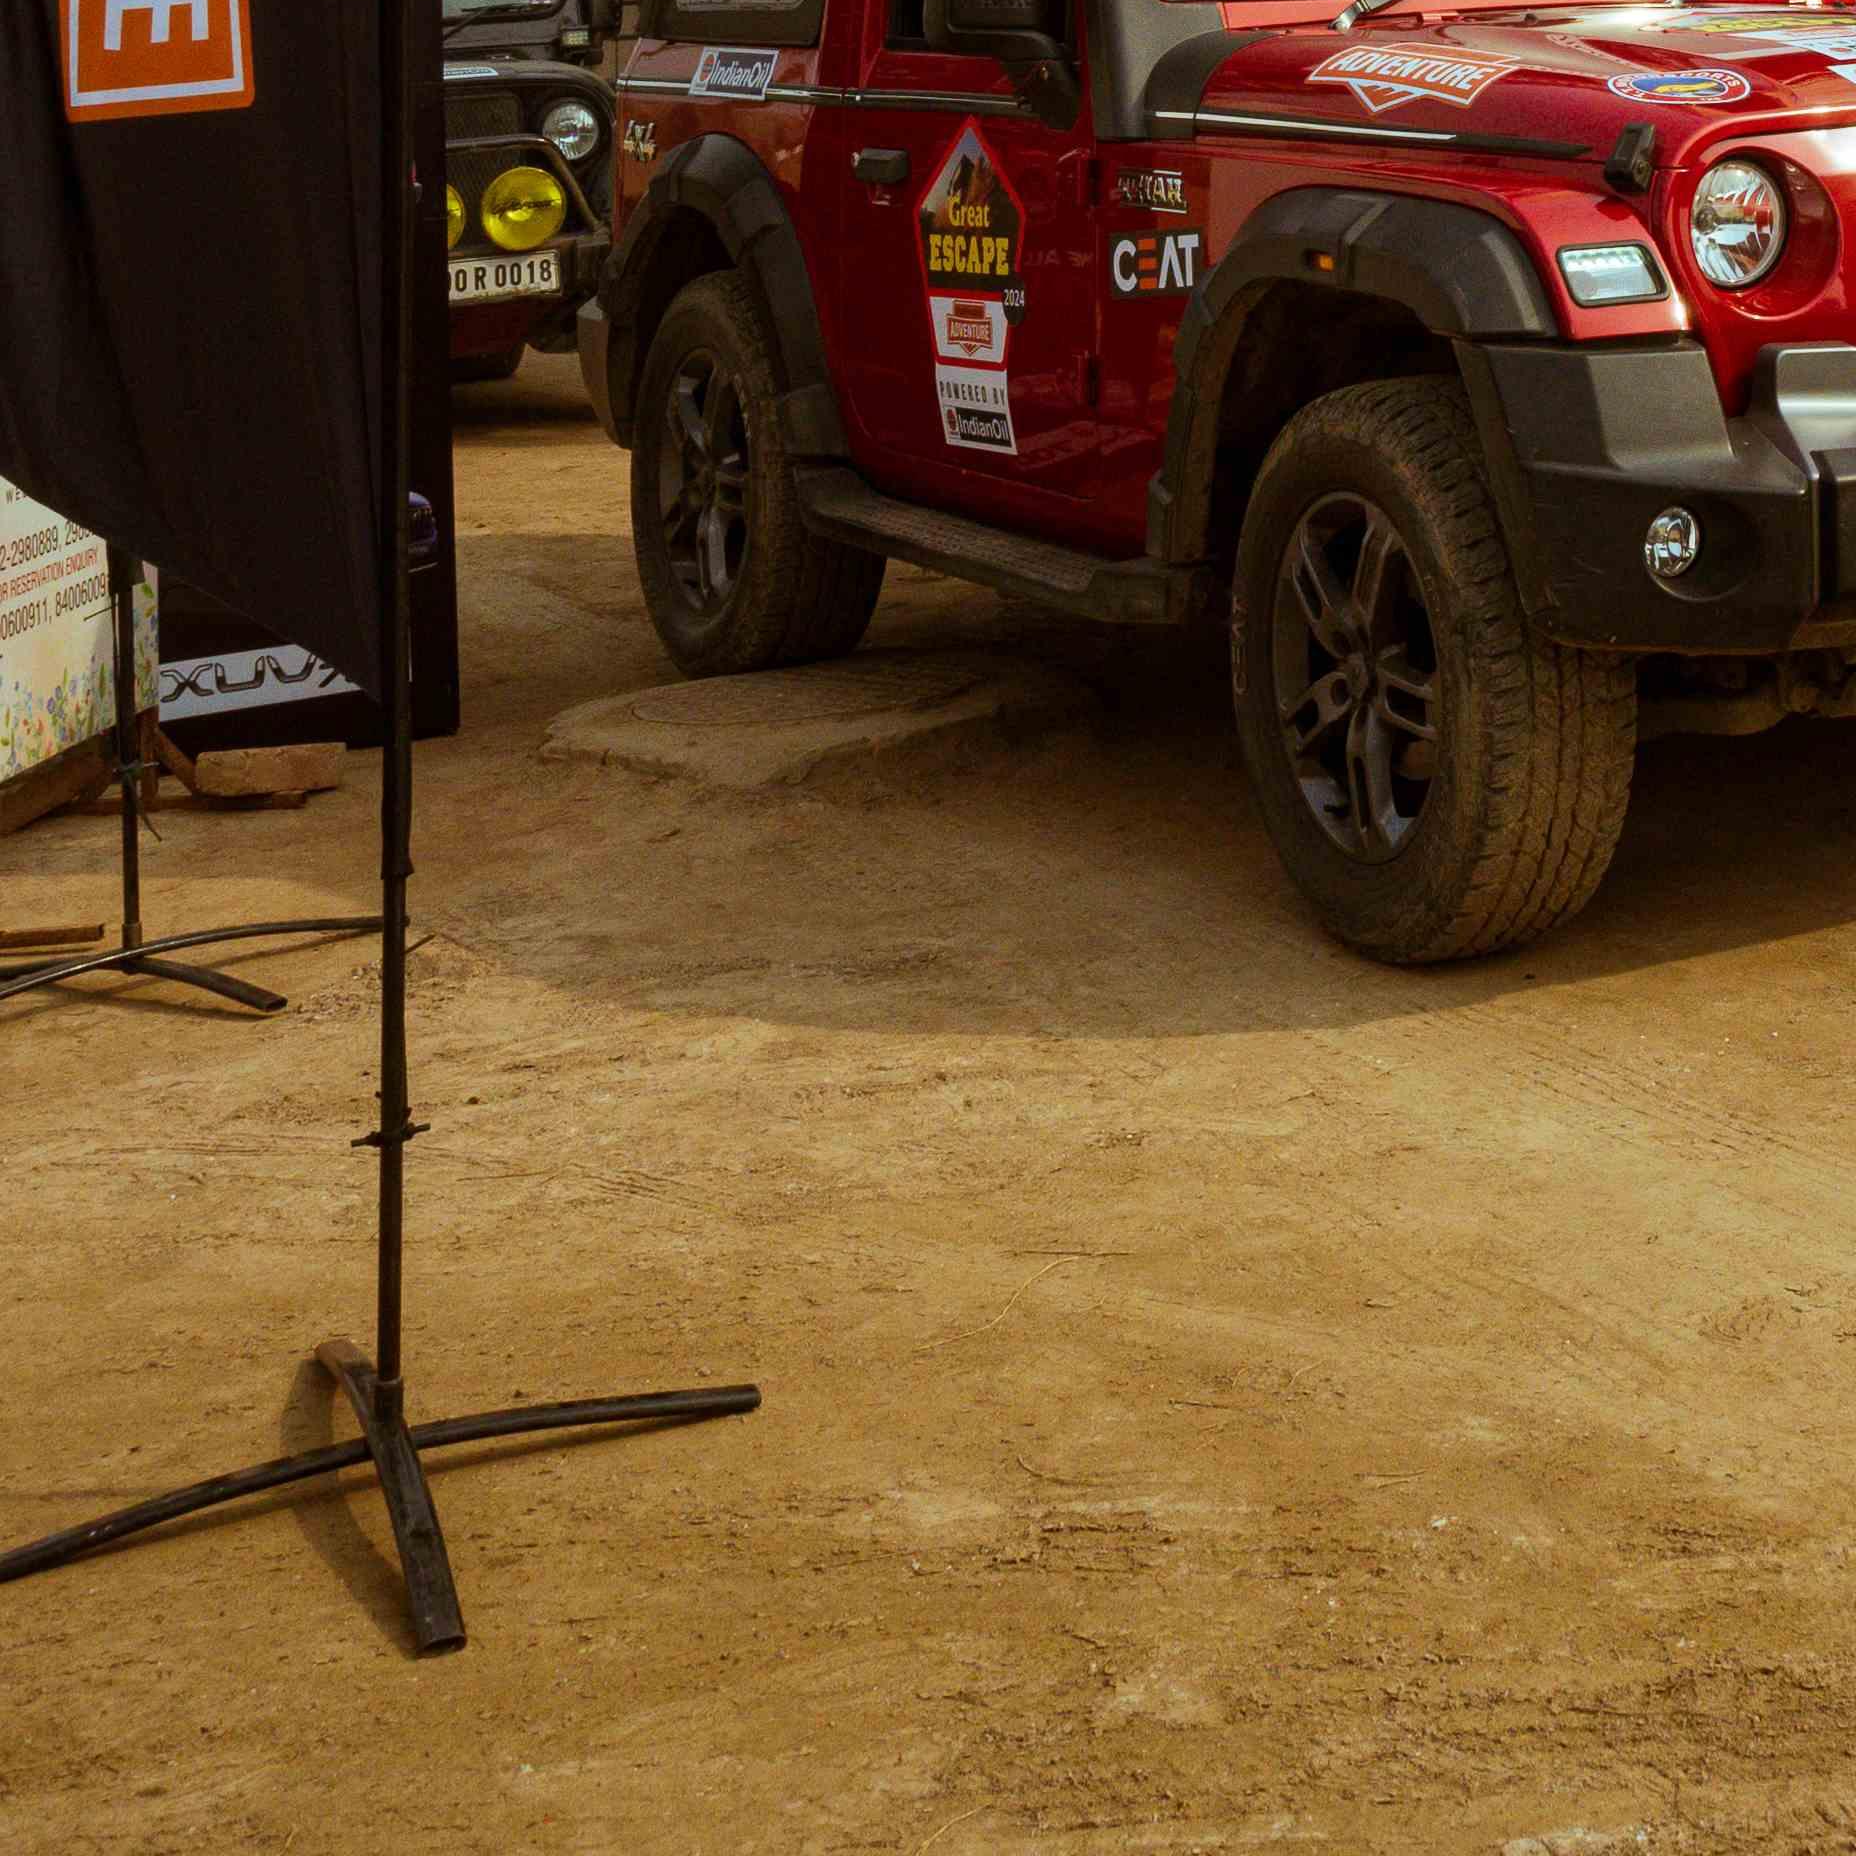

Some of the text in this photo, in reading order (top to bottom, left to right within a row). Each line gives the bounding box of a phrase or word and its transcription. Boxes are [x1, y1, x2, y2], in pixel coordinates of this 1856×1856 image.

[709, 55, 773, 89] IndianOil
[1327, 51, 1496, 91] ADVENTURE
[948, 195, 991, 228] Great
[928, 233, 1010, 276] ESCAPE
[1113, 234, 1200, 292] CEAT
[495, 259, 552, 288] 0018
[1003, 288, 1026, 308] 2024
[940, 380, 1006, 406] POWERED BY
[958, 413, 1010, 441] IndianOil
[11, 562, 65, 595] RESERVATION
